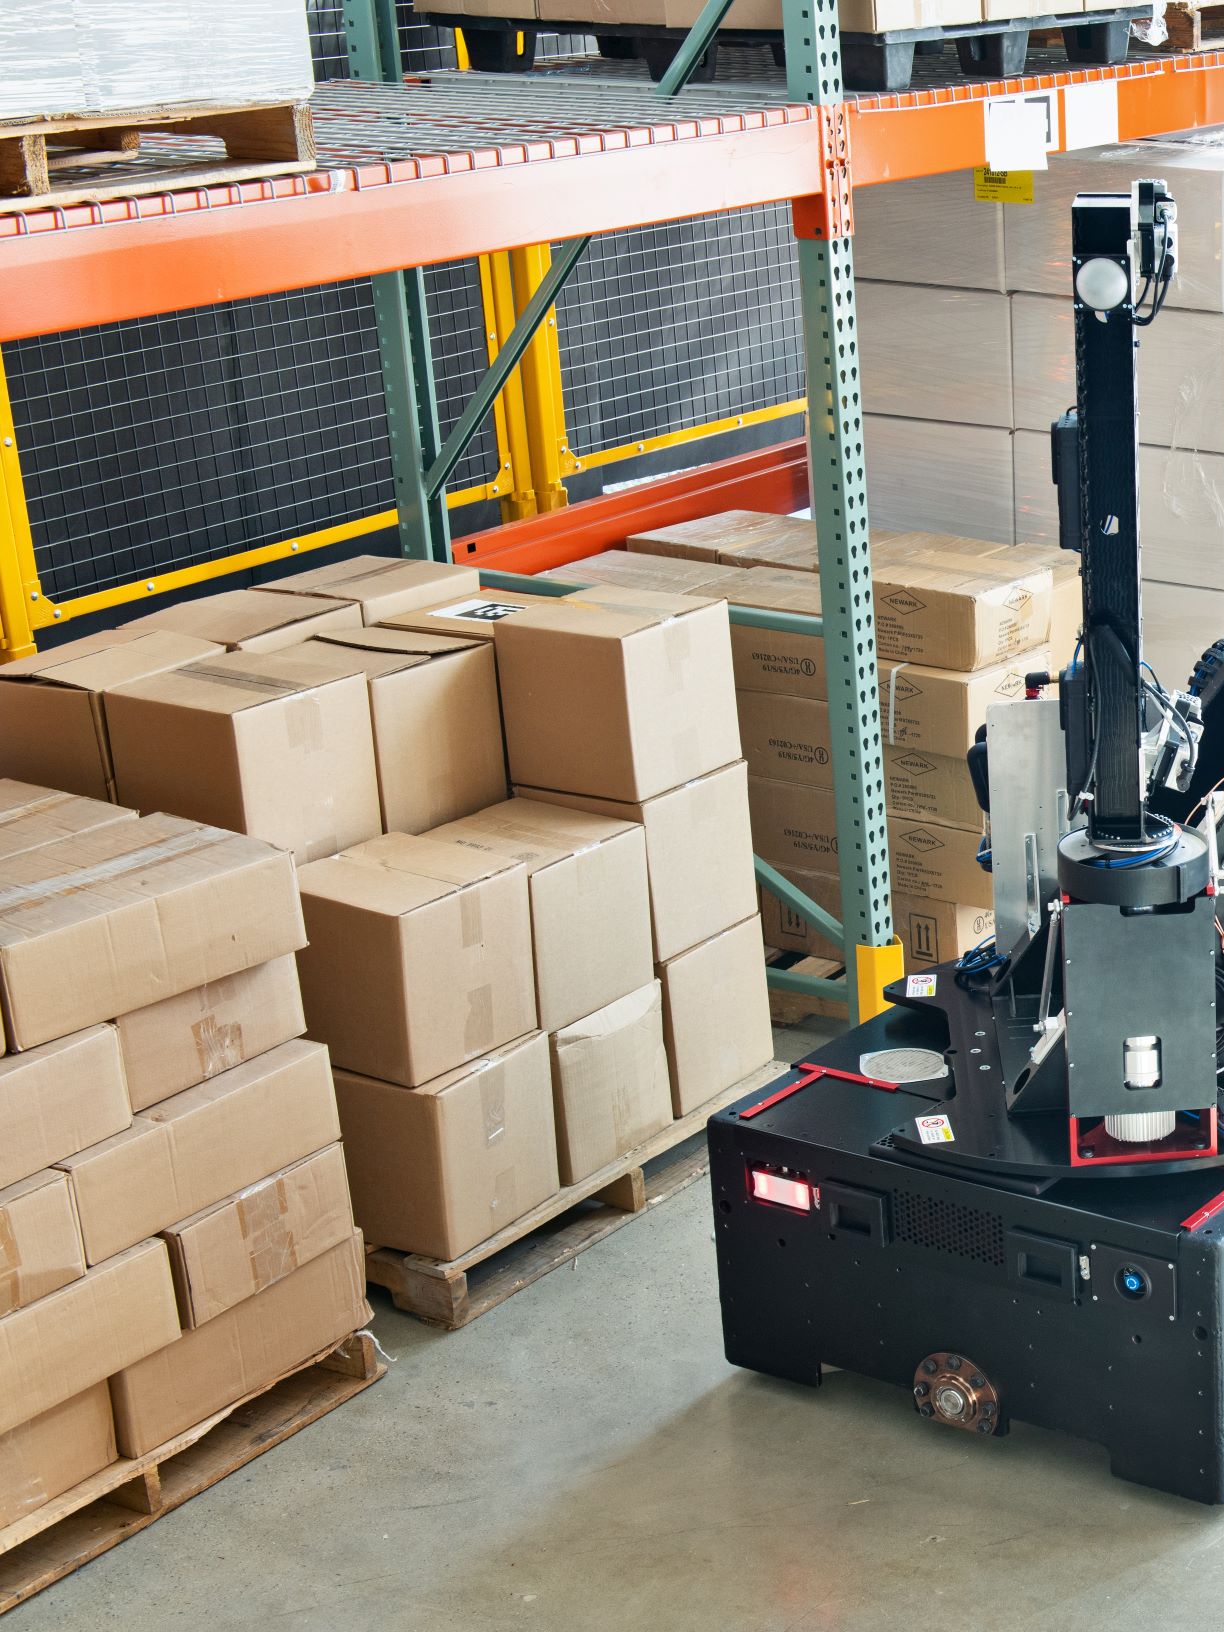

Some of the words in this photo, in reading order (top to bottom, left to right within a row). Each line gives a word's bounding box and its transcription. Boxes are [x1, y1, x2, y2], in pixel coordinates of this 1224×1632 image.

[889, 598, 919, 608] NEWARK
[886, 683, 914, 693] NWARK
[900, 760, 929, 770] NEWARK
[908, 835, 936, 846] NEWARK
